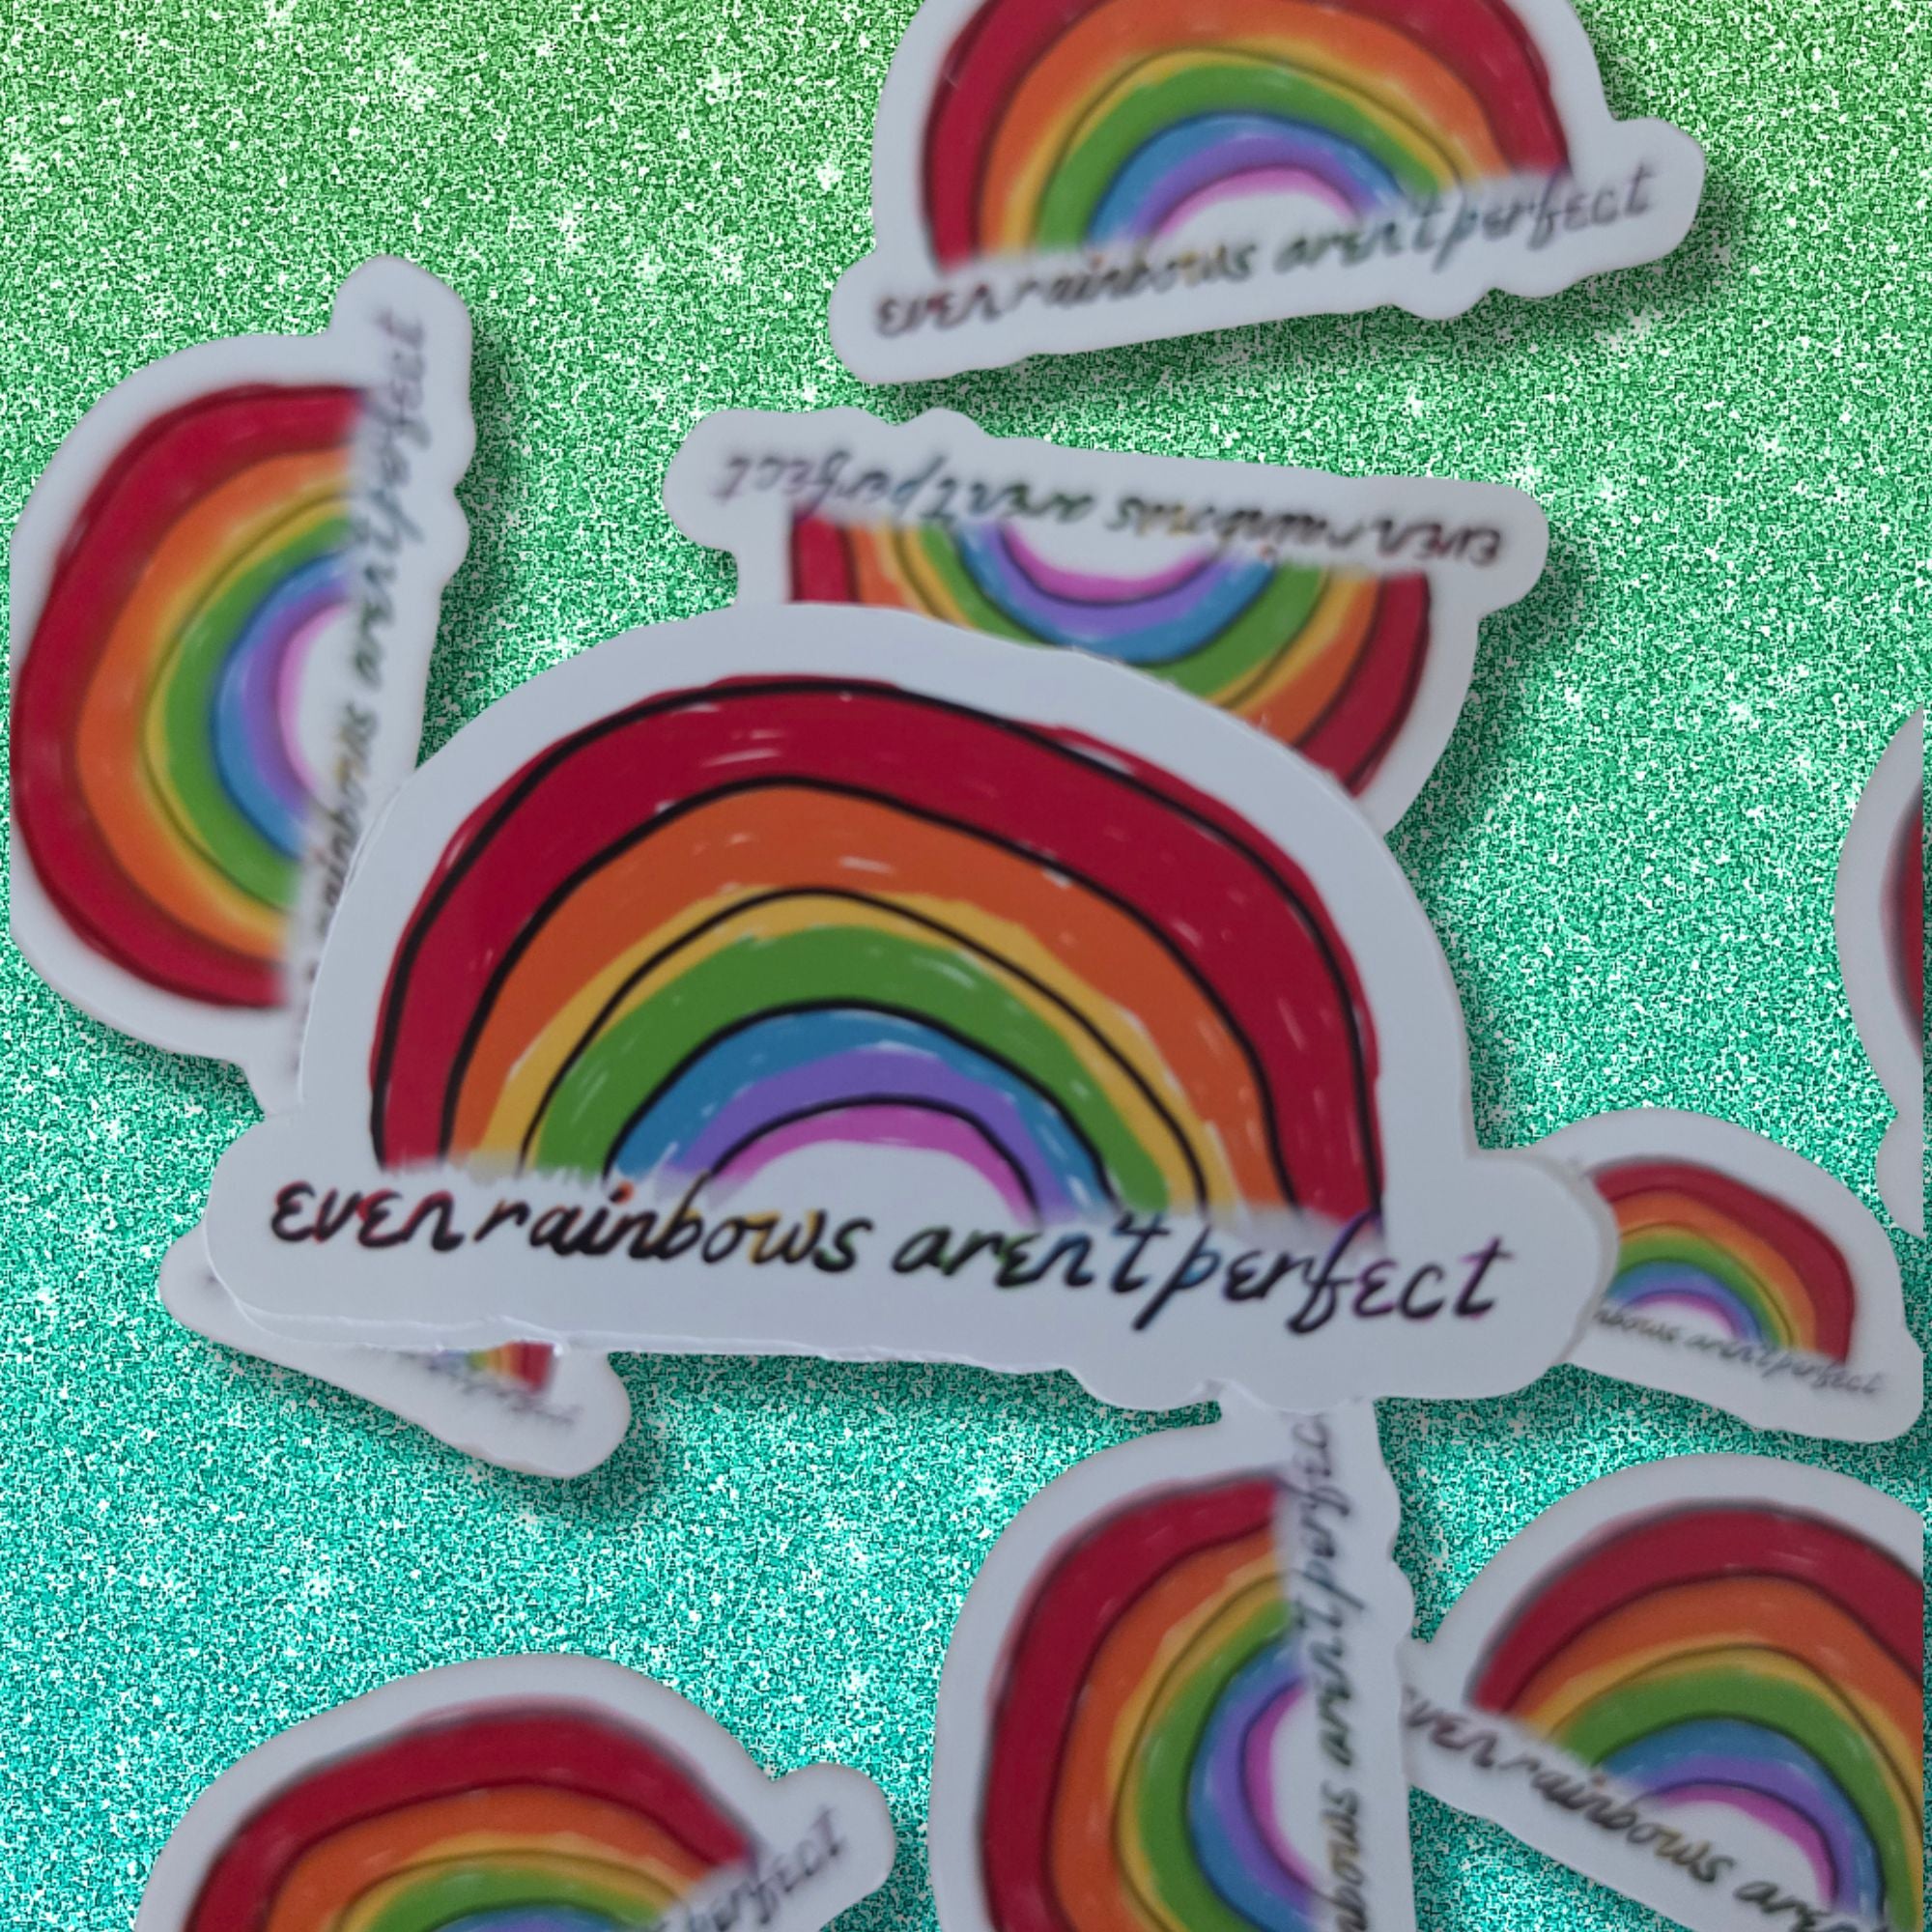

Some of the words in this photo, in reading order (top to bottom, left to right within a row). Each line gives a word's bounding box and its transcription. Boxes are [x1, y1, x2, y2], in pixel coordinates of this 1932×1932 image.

[1432, 164, 1656, 274] perfect
[710, 448, 952, 526] perfect
[270, 1180, 467, 1253] even
[473, 1169, 874, 1274] rainbows
[1131, 1208, 1515, 1336] perfect
[1281, 1412, 1365, 1611] perfec
[1404, 1683, 1498, 1769] ven
[1497, 1750, 1736, 1885] rainbows
